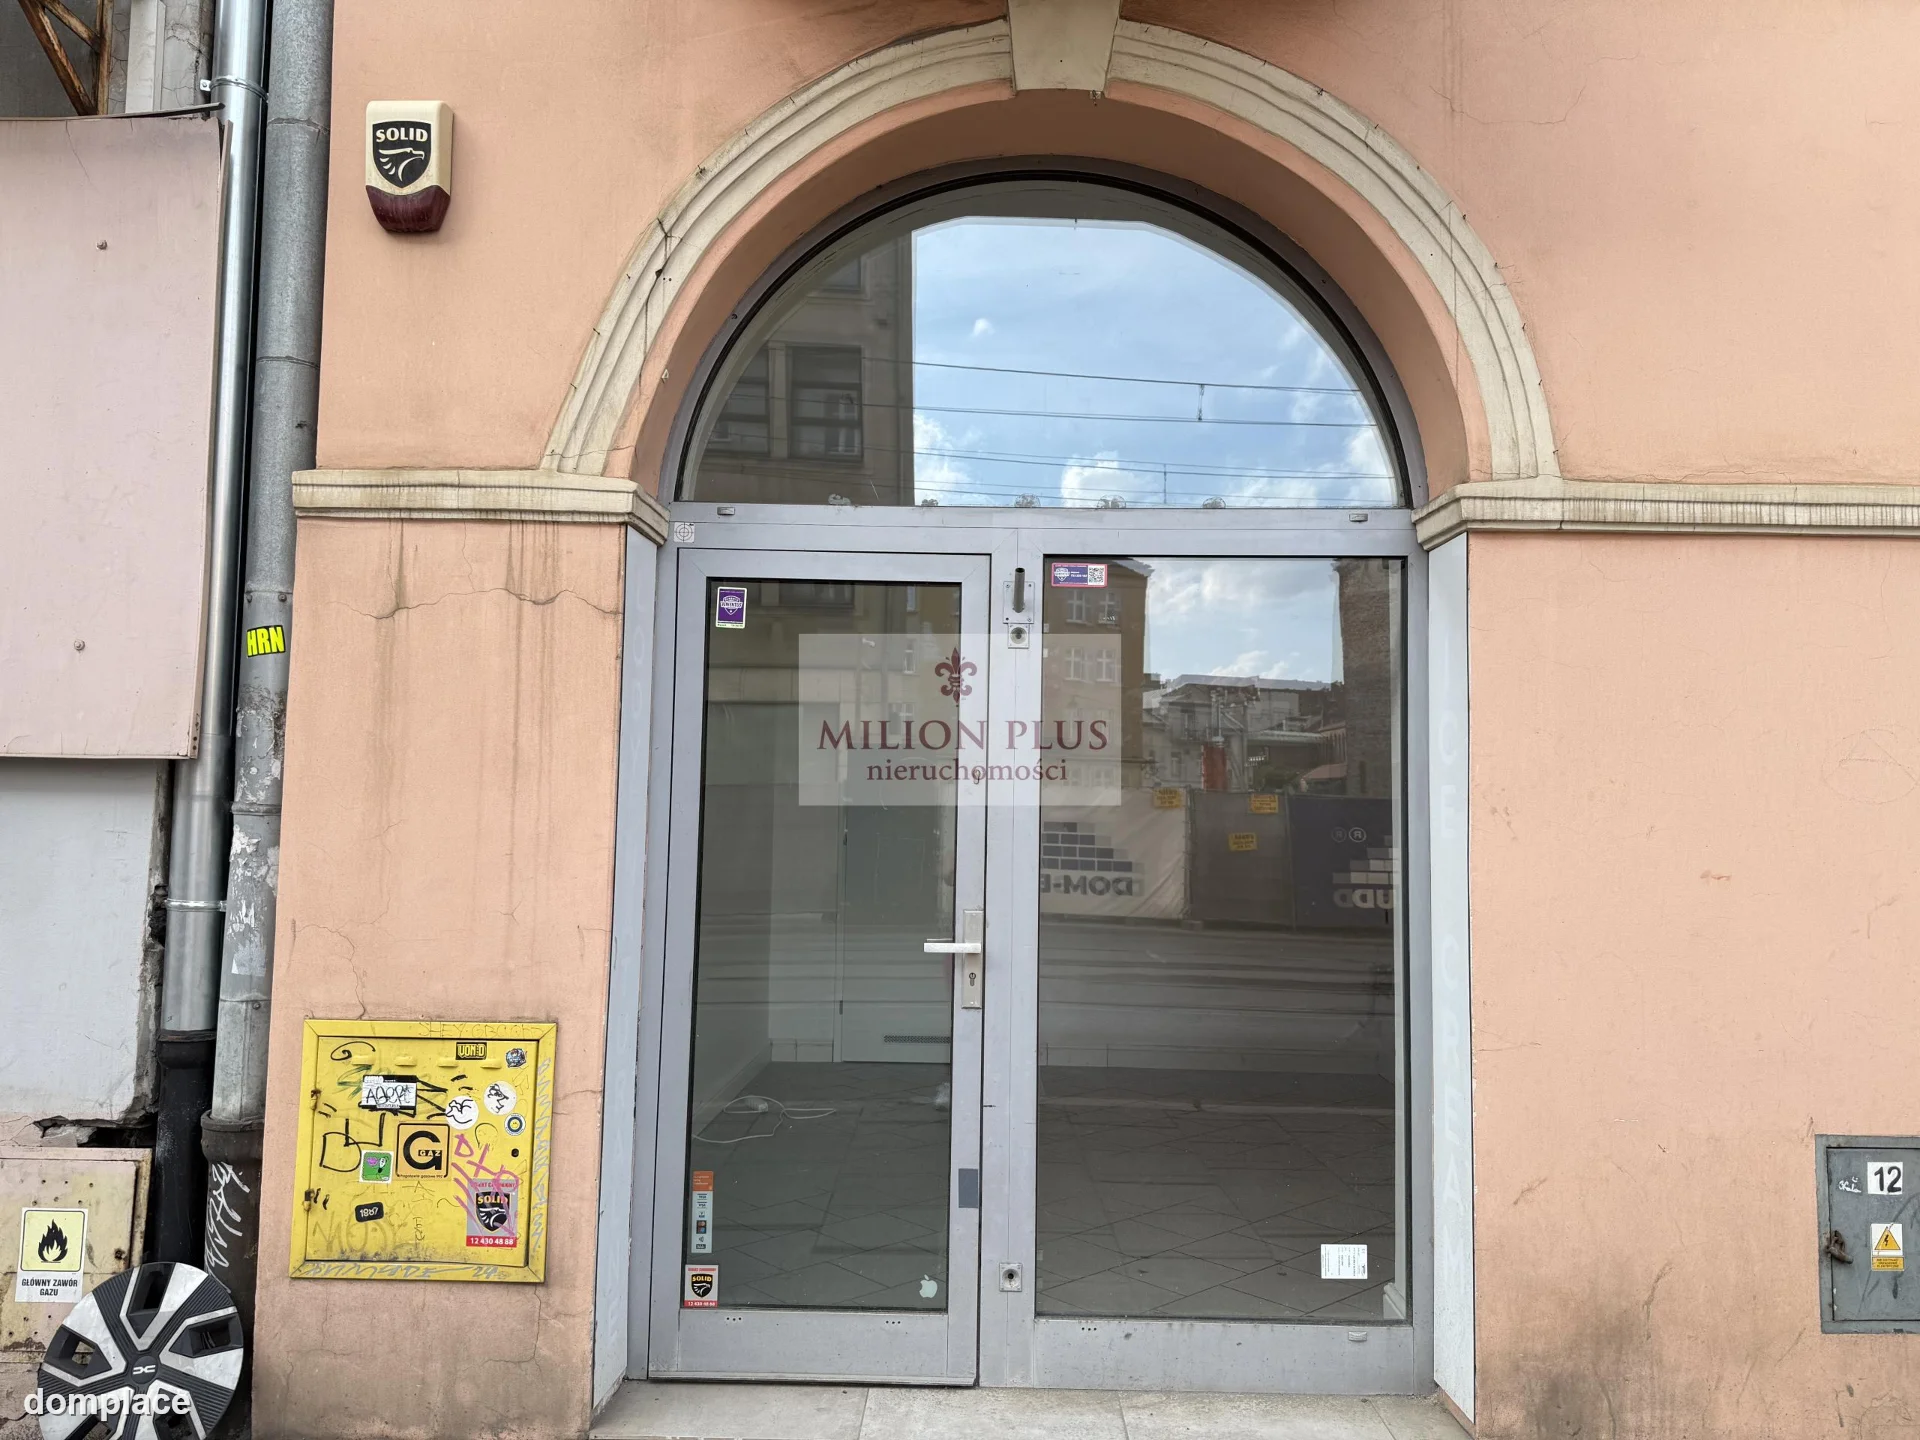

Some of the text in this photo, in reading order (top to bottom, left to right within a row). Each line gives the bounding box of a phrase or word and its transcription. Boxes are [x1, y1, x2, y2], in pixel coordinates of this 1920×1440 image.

[375, 127, 429, 143] SOLID
[247, 626, 285, 657] HRN
[1873, 1165, 1902, 1193] 12
[477, 1194, 509, 1205] SOLID
[480, 1237, 494, 1245] 430
[21, 1276, 78, 1288] GŁÓWNY ZAWÓR
[39, 1288, 59, 1297] GAZU
